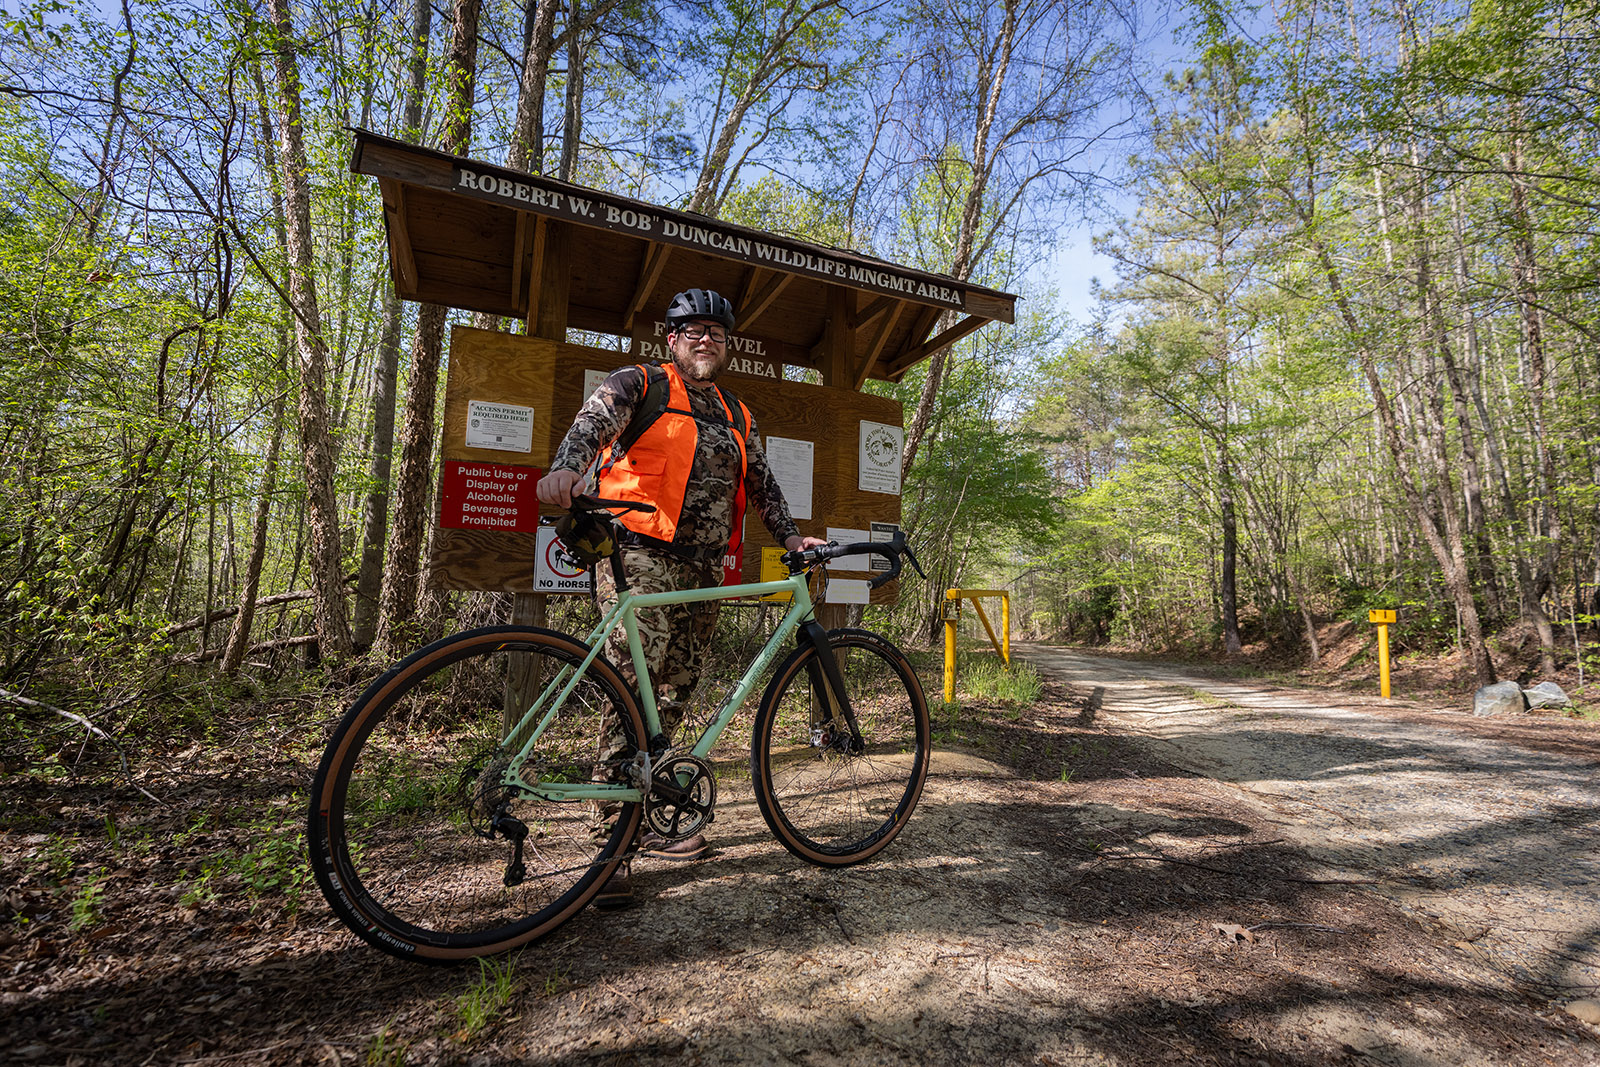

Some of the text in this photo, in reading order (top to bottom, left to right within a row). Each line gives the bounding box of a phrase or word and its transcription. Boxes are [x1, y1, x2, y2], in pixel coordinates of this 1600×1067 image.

[459, 168, 962, 305] ROBERT W. "BOB" DUNCAN WILDLIFE MNGMT AREA
[728, 357, 777, 379] AREA
[473, 411, 509, 420] REQUIRED
[475, 405, 528, 416] ACCESS PERMIT
[458, 466, 491, 477] Public
[494, 469, 514, 479] Use
[466, 479, 519, 492] Display of
[466, 491, 516, 503] Alcoholic
[462, 503, 518, 516] Beverages
[462, 515, 517, 527] Prohibited
[539, 580, 590, 588] NO HORSE
[376, 931, 415, 952] challenge
